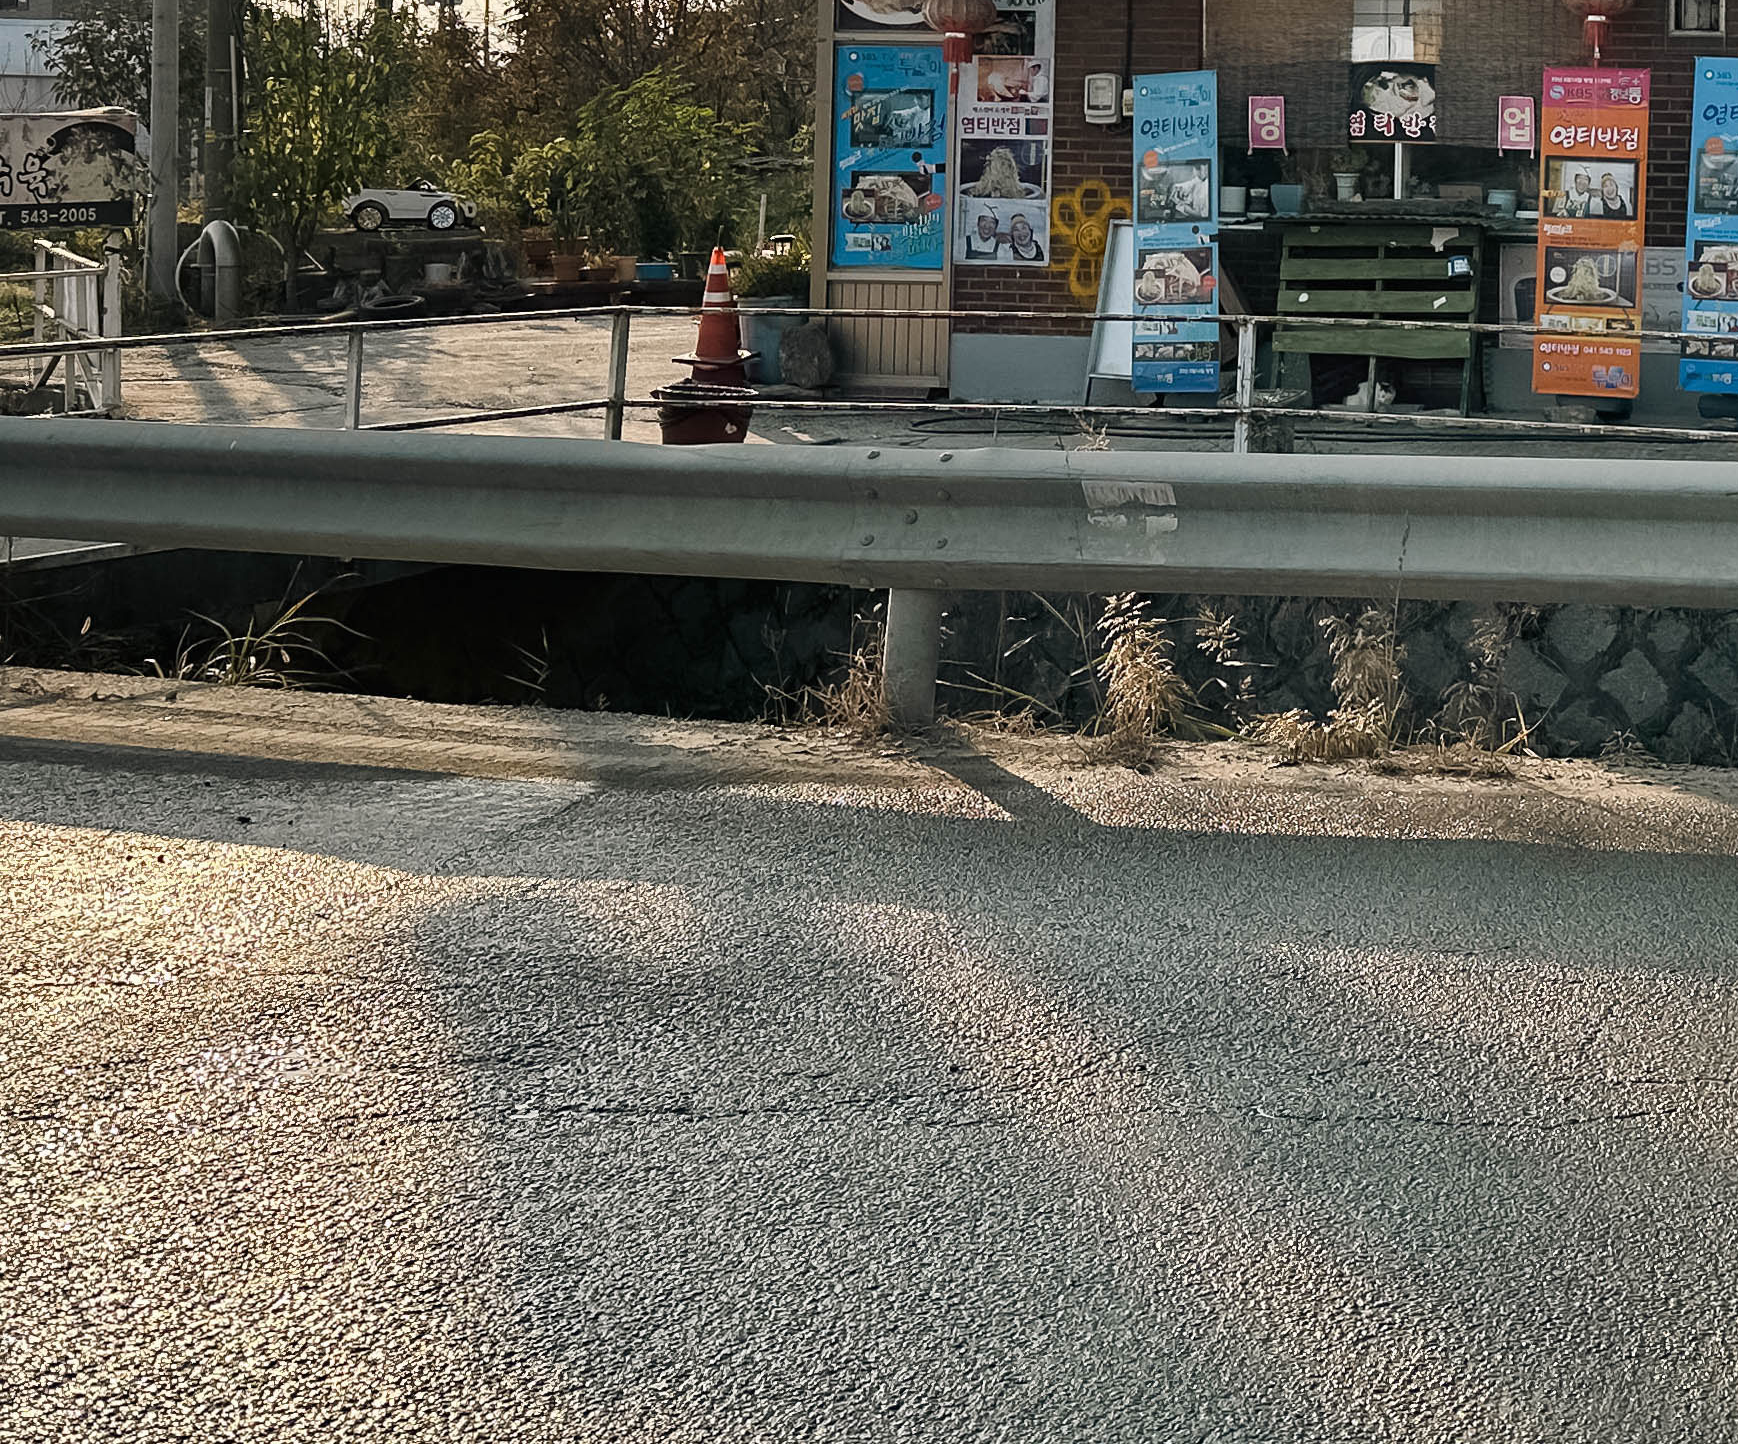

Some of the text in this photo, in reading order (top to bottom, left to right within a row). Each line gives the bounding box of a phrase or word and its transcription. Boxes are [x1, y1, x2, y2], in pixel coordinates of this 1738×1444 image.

[1567, 89, 1593, 100] KBS
[961, 116, 1021, 135] 염티반점
[1140, 114, 1210, 139] 염티반점
[1253, 106, 1280, 142] 영
[1503, 107, 1531, 141] 업
[1550, 125, 1640, 151] 염티반점
[20, 207, 97, 224] 543-2005
